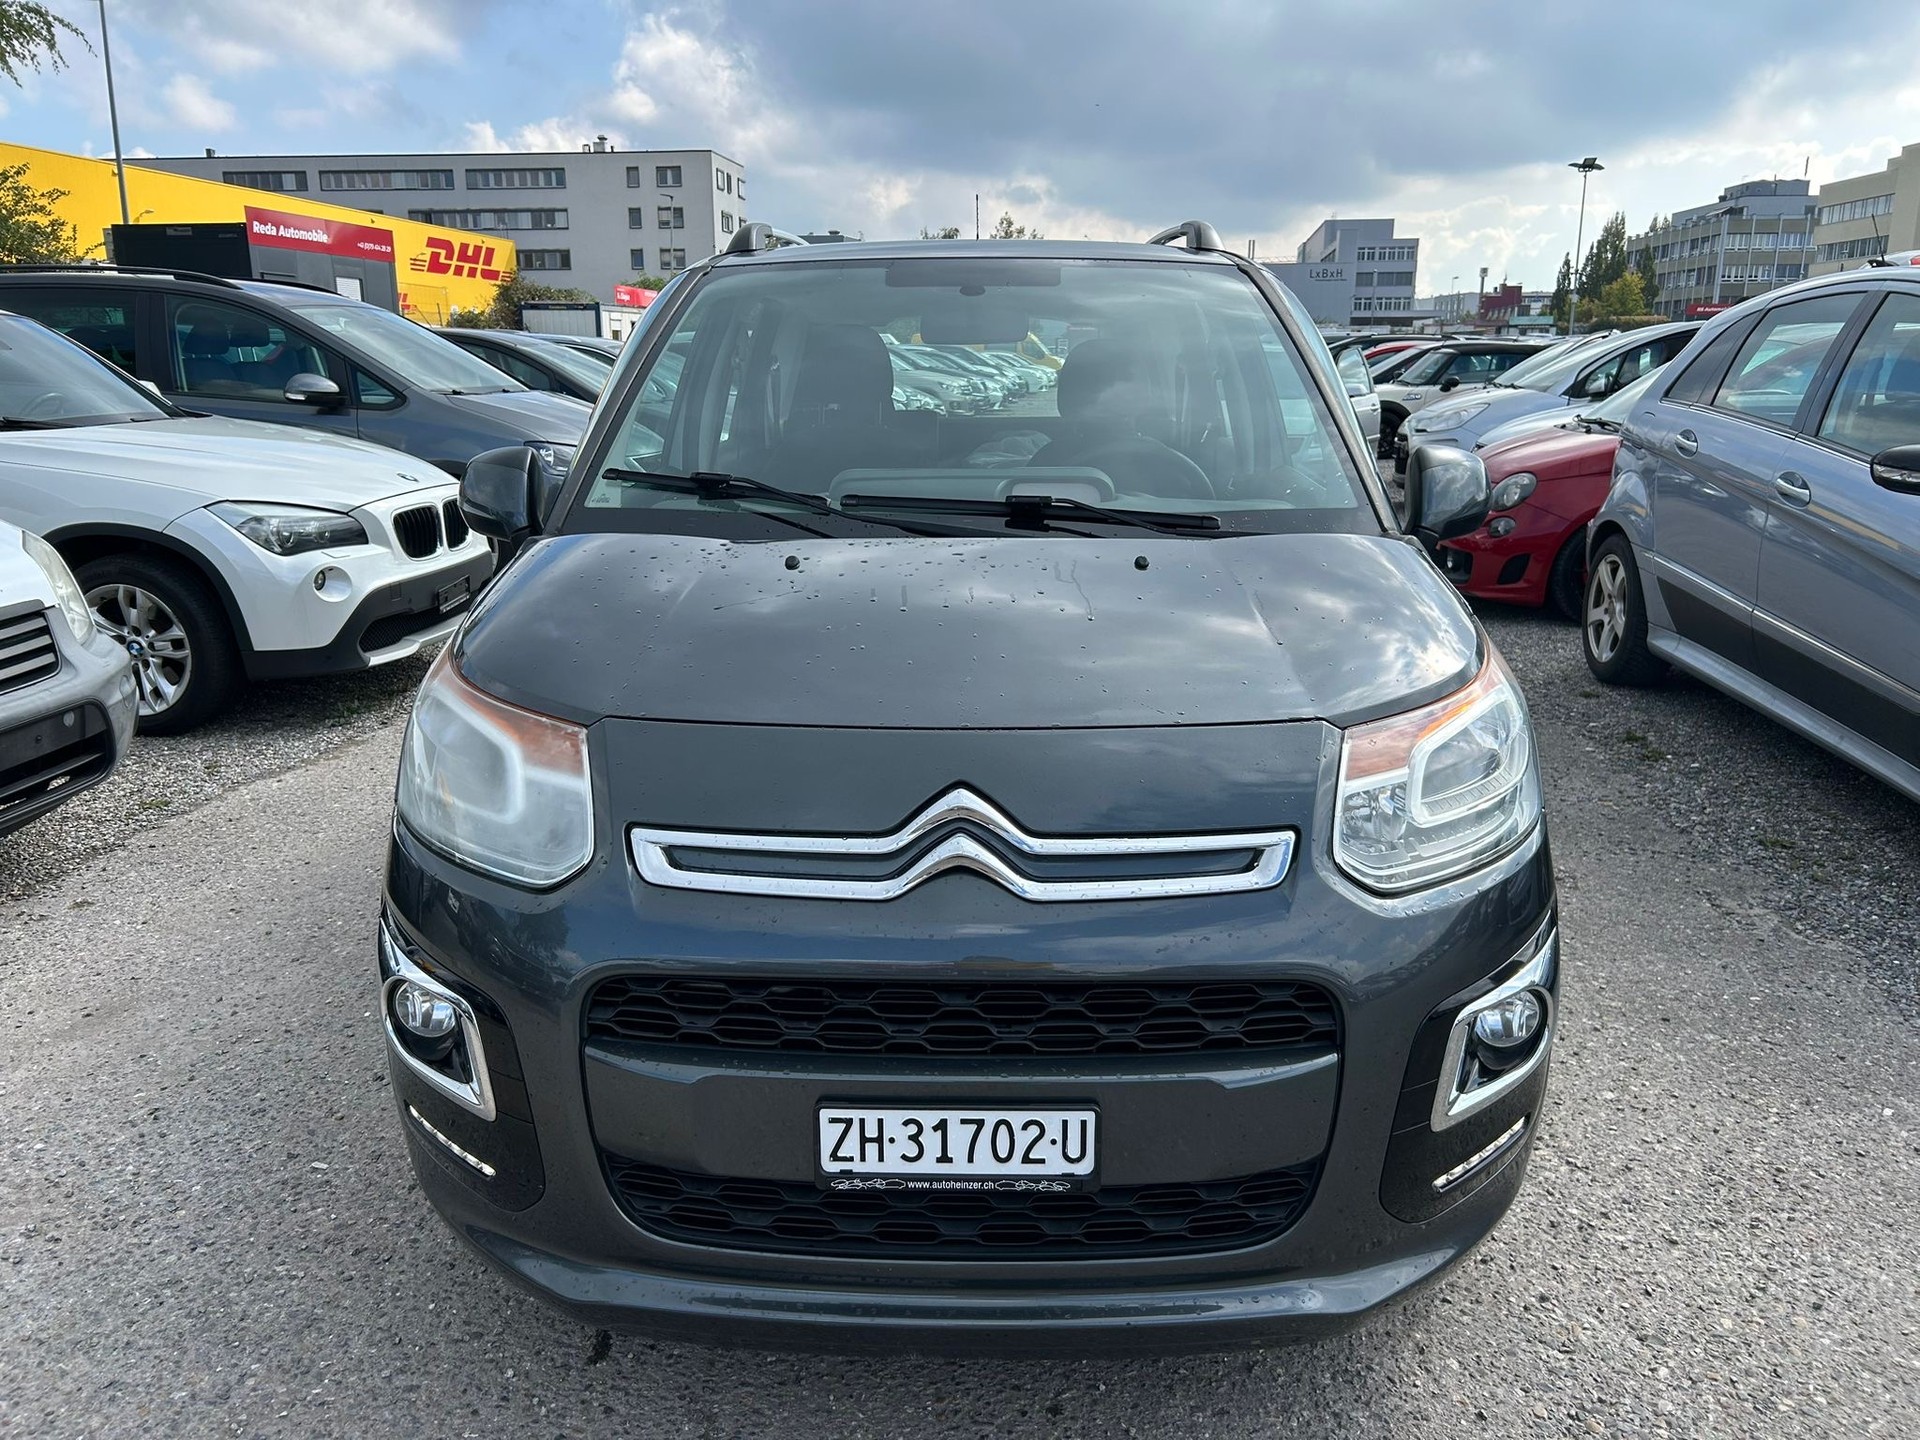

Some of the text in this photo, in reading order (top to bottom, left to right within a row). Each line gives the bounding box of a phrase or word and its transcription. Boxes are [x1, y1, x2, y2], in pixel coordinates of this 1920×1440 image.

[252, 220, 329, 243] Reda Automobile
[425, 236, 502, 282] DHL
[907, 1180, 994, 1190] www.autoheinzer.ch
